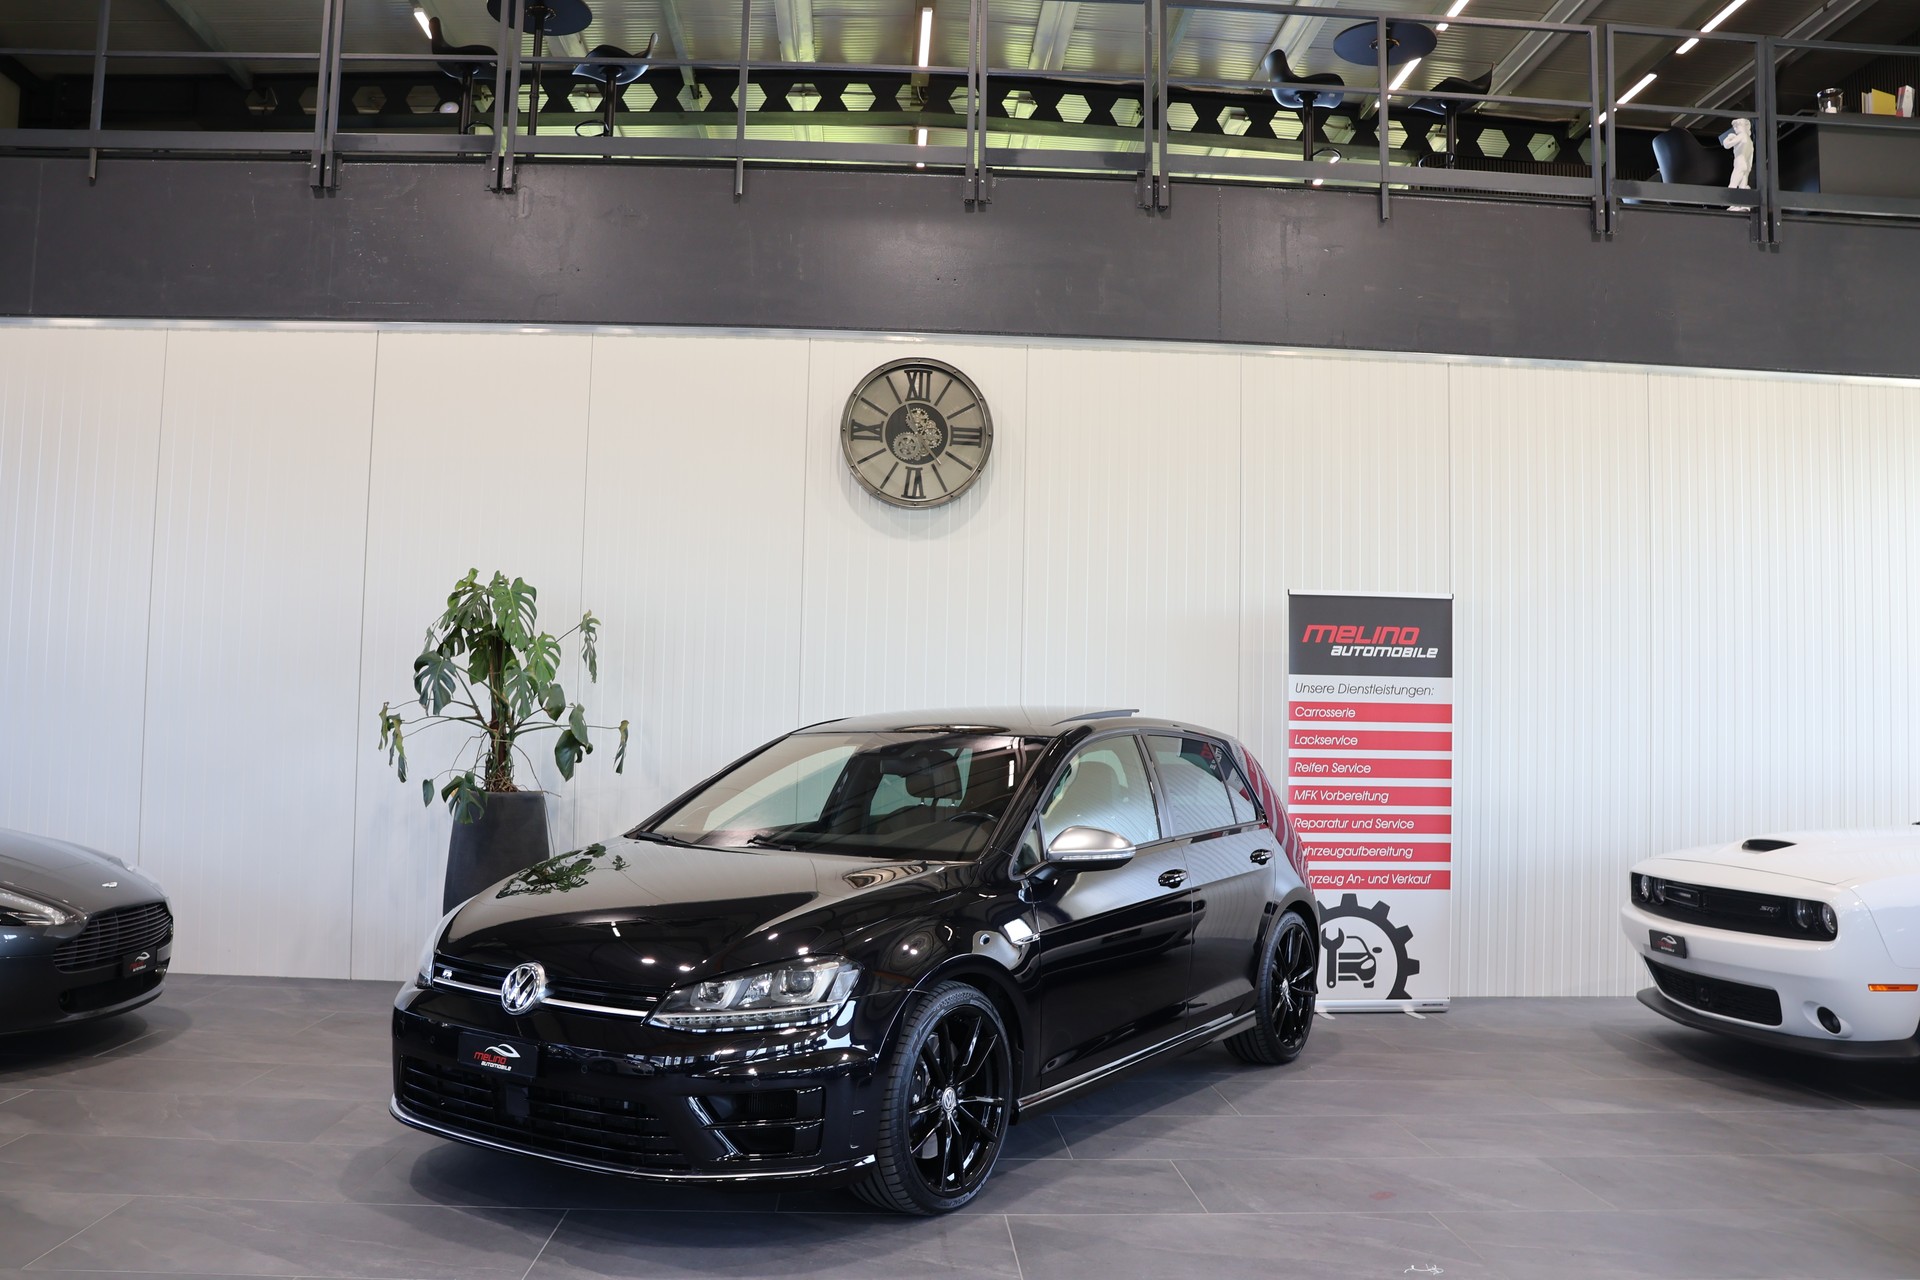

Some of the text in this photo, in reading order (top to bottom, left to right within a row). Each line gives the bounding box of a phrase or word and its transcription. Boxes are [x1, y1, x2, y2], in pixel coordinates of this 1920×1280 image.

[904, 369, 933, 402] XII
[1295, 683, 1435, 698] Unsere Dienstleistungen:
[1295, 706, 1356, 718] Carrosserie
[1294, 734, 1358, 746] Lackservice
[1294, 762, 1371, 774] Reifen Service
[1294, 790, 1389, 804] MFK Vorbereitung
[1294, 818, 1415, 830] Reparatur und Service
[1303, 846, 1414, 860] hrzeugaufbereitung
[1346, 874, 1365, 884] An-
[1368, 875, 1390, 885] und
[1391, 874, 1432, 885] Verkauf
